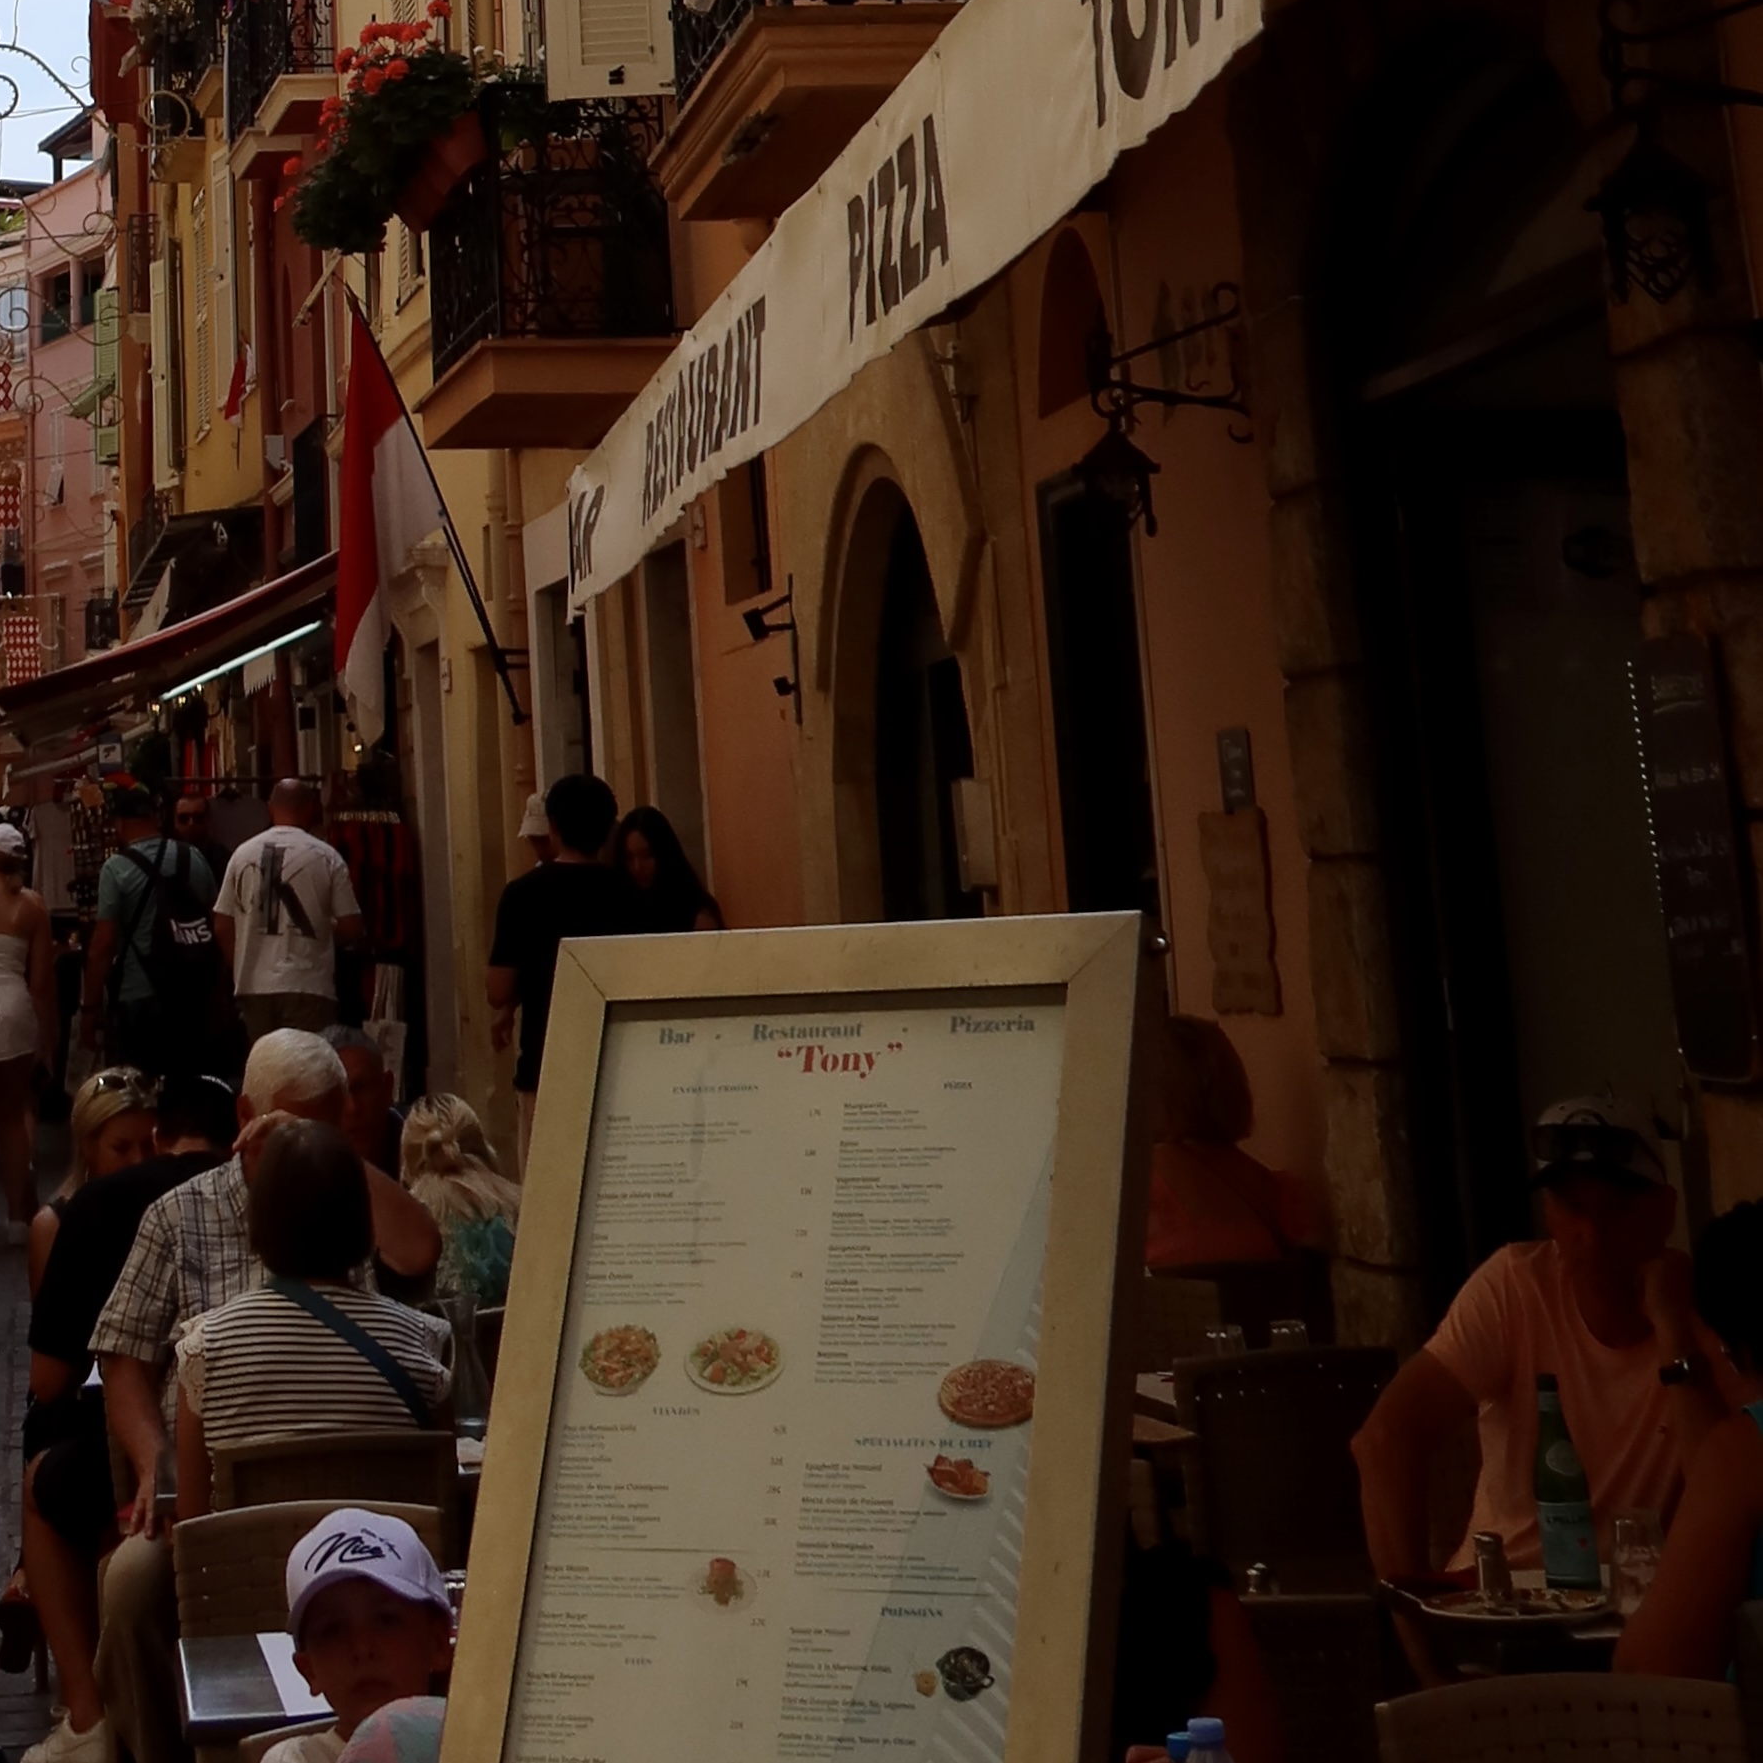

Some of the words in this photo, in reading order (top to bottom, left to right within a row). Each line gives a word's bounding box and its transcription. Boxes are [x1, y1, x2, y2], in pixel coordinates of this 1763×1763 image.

[568, 484, 605, 594] AR
[643, 295, 766, 526] RESTAURANT
[846, 111, 951, 342] PIZZA
[659, 1027, 696, 1045] Bar
[753, 1020, 863, 1041] Restaurant
[949, 1014, 1035, 1034] Pizzeria
[304, 1562, 386, 1605] Nice
